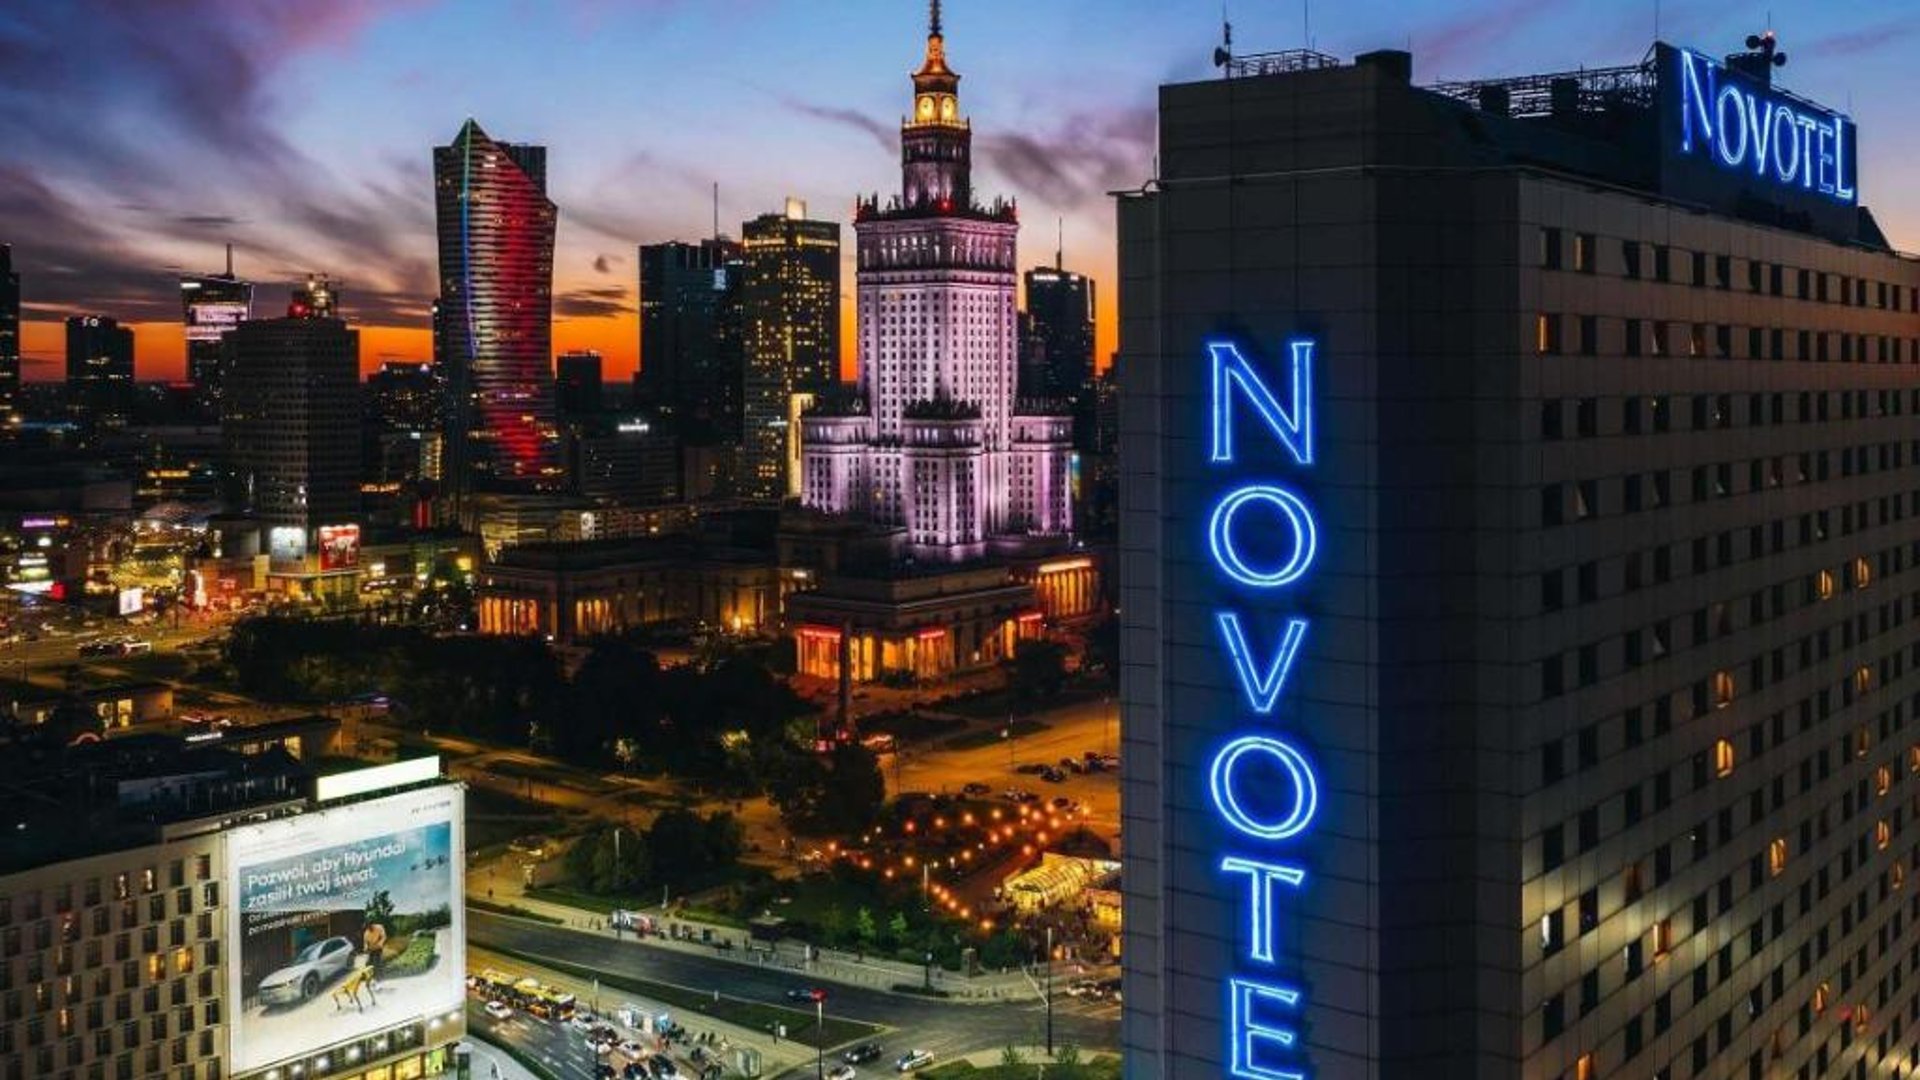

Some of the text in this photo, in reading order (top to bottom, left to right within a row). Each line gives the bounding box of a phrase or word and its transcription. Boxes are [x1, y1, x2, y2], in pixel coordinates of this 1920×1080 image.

[1681, 49, 1853, 200] NOVOTEL
[312, 856, 341, 874] aby
[344, 839, 406, 867] Hyundai
